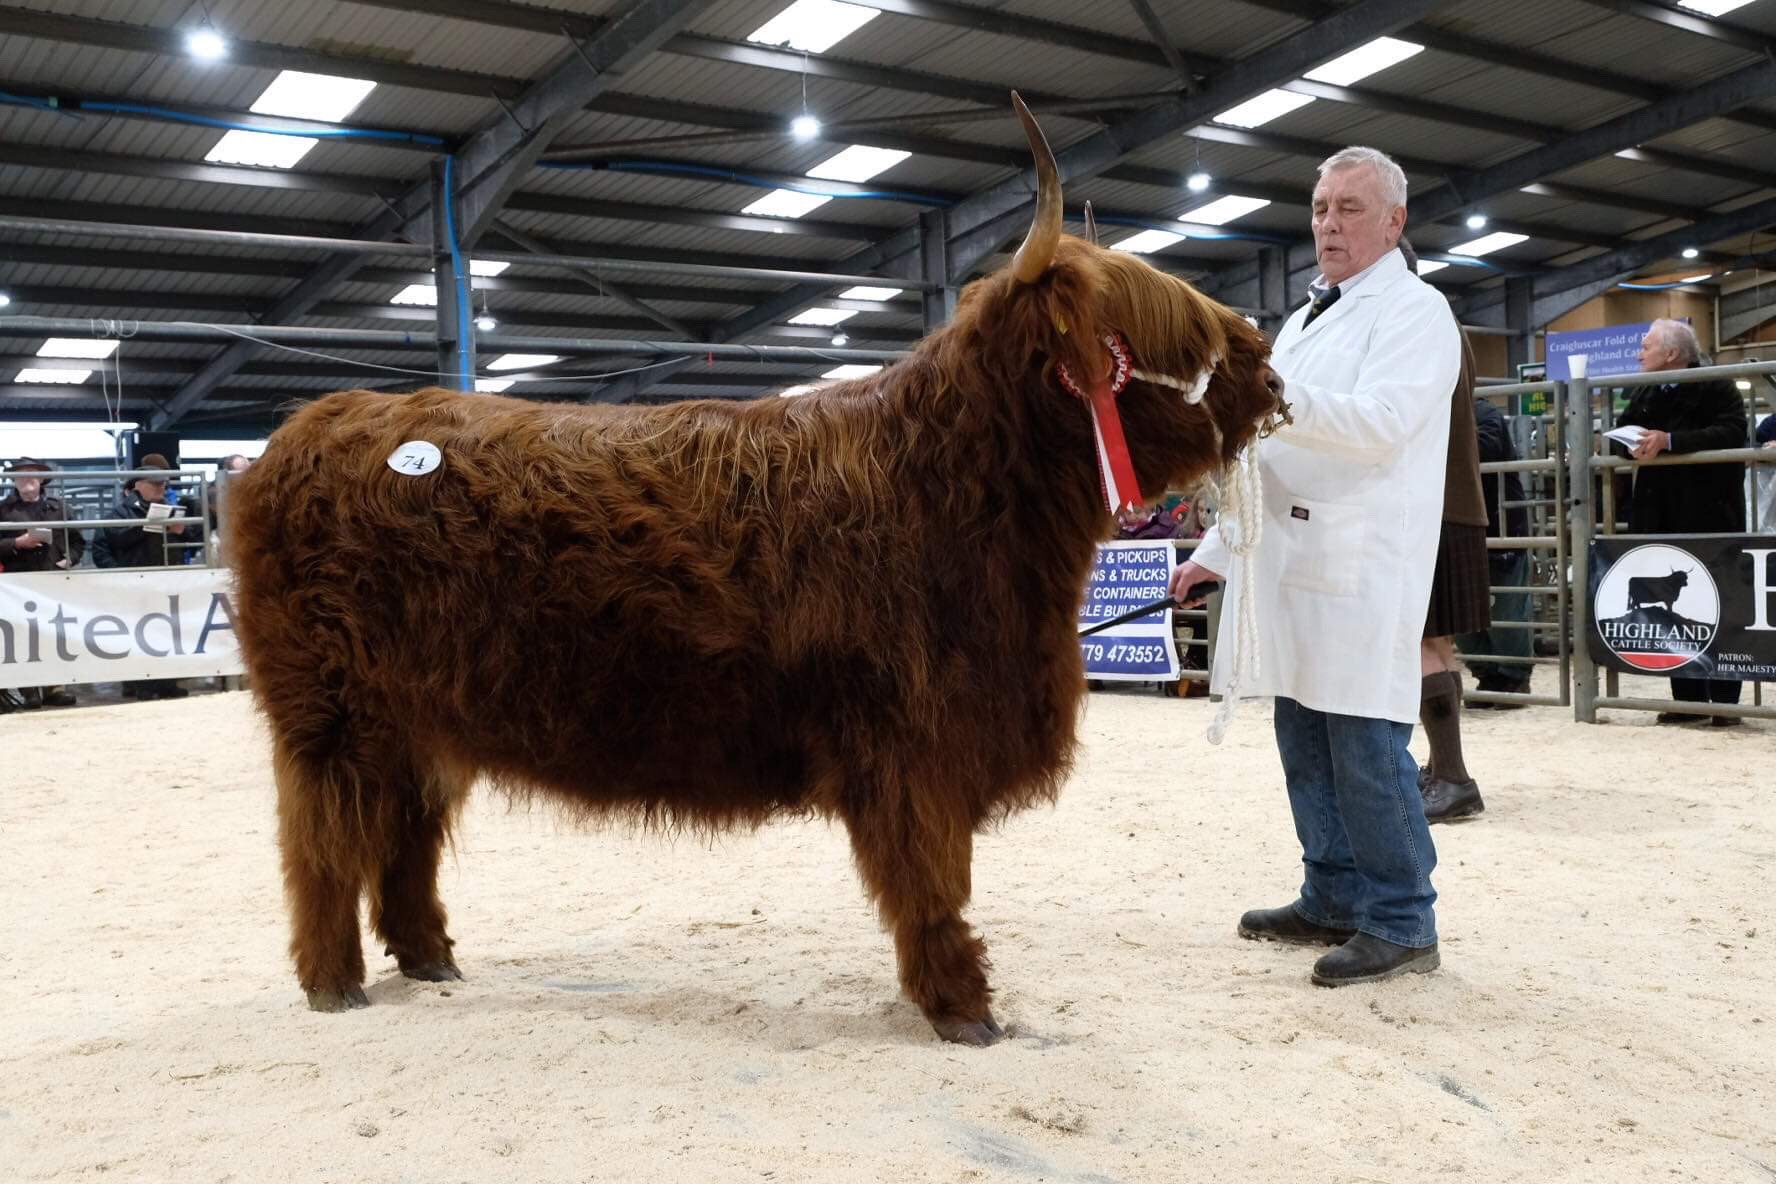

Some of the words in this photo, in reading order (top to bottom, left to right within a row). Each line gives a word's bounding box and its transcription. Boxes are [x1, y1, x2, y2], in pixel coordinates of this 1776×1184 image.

[1604, 334, 1625, 346] Fold
[1627, 333, 1638, 344] of
[1588, 349, 1621, 363] ghland
[401, 455, 425, 470] 74
[1096, 551, 1104, 564] S
[1106, 551, 1115, 564] &
[1117, 550, 1166, 564] PICKUPS
[1090, 569, 1106, 582] NS
[1109, 569, 1118, 582] &
[1120, 568, 1167, 582] TRUCKS
[1093, 586, 1166, 600] CONTAINERS
[1079, 604, 1101, 617] BLE
[1605, 622, 1711, 641] HIGHLAND
[1611, 639, 1651, 649] CATTLE
[1654, 640, 1702, 651] SOCIETY
[1081, 644, 1104, 662] 79
[1107, 644, 1165, 663] 473552
[1718, 653, 1754, 662] PATRON:
[1717, 664, 1736, 673] HER
[1737, 664, 1776, 673] MAJESTY
